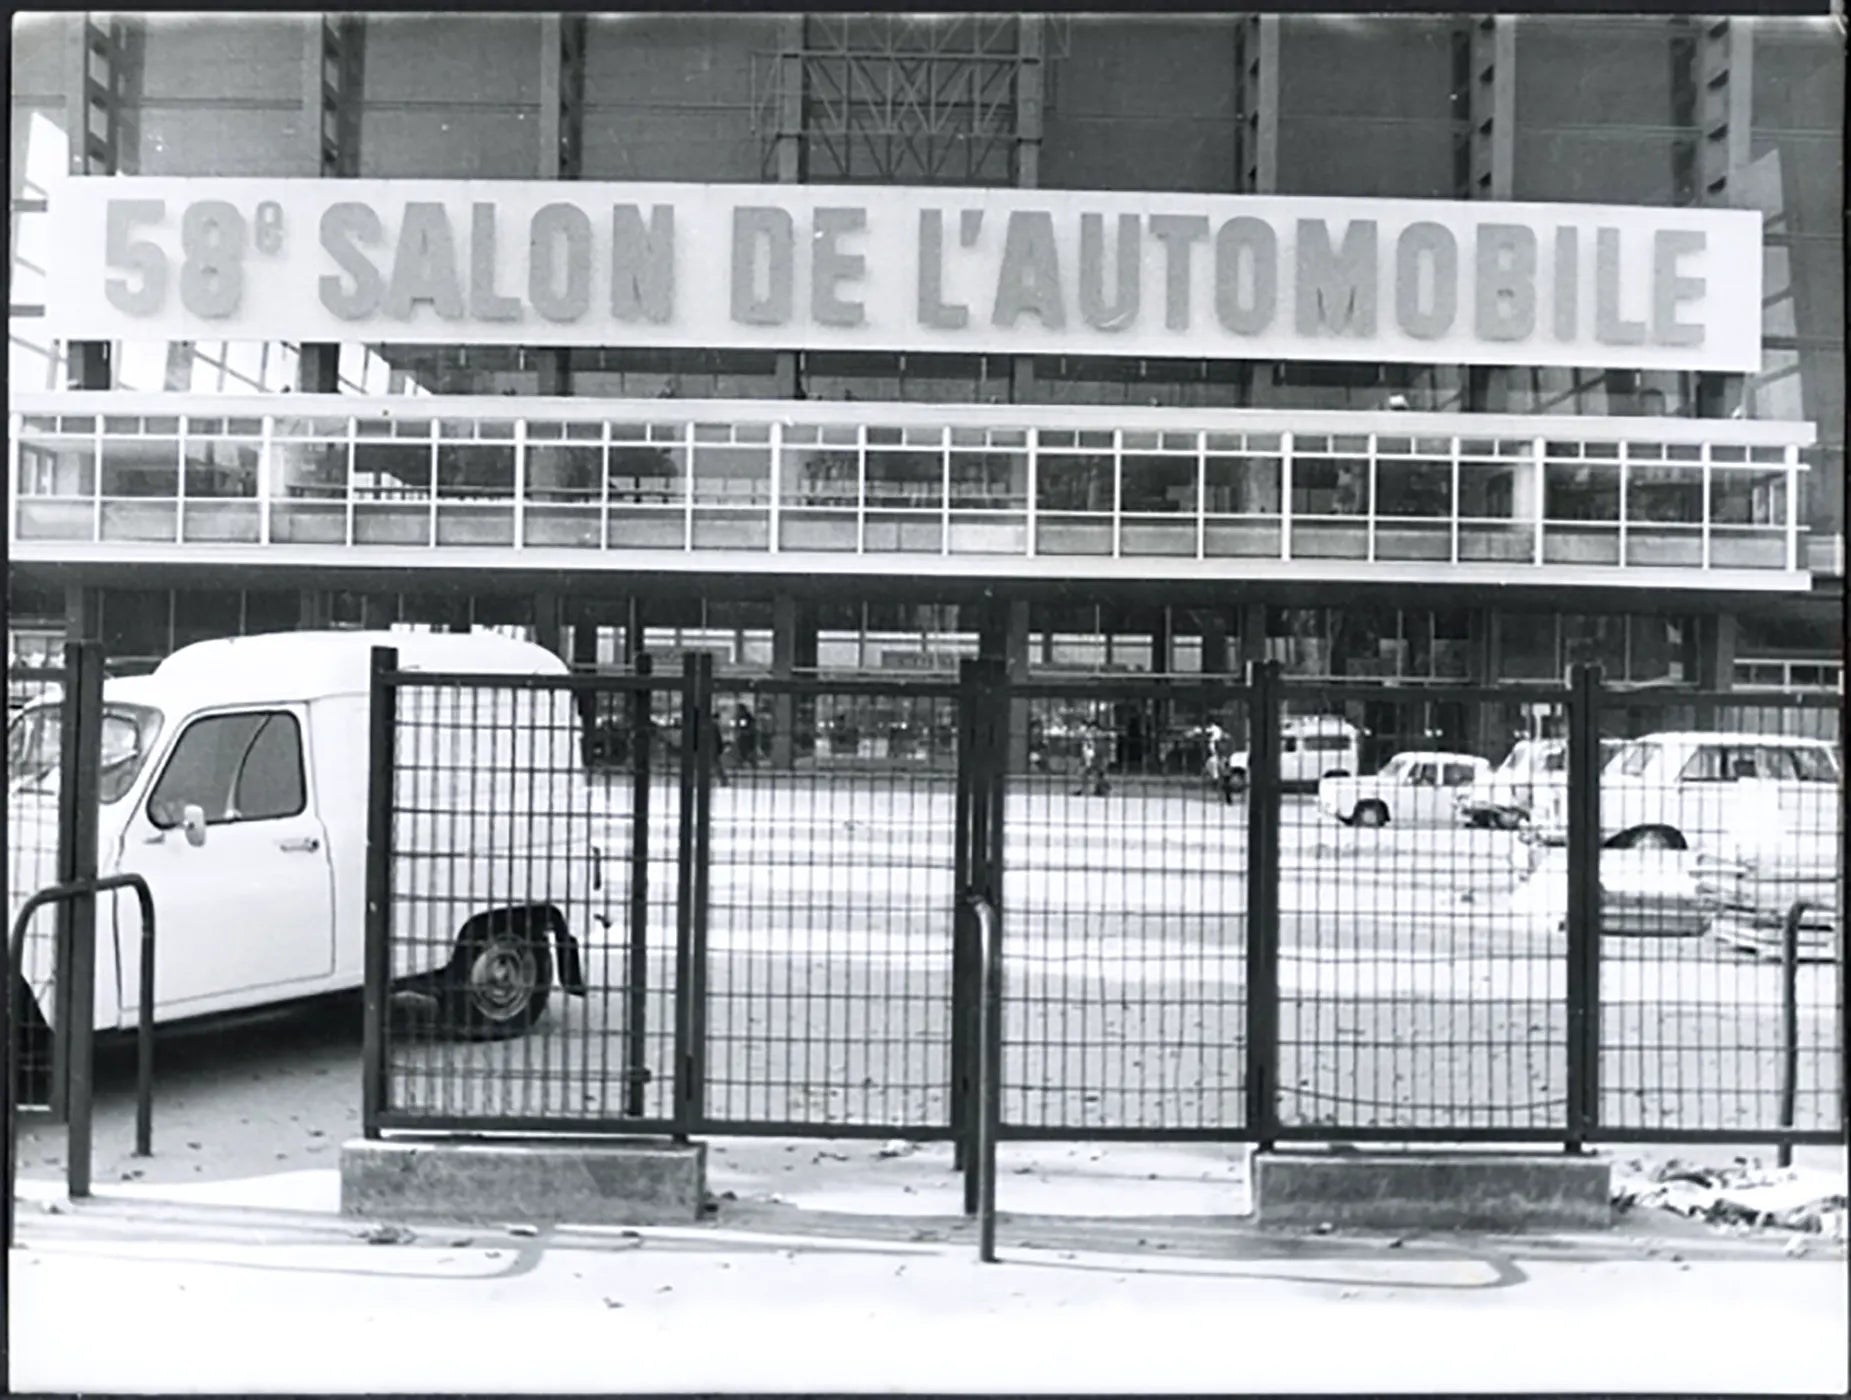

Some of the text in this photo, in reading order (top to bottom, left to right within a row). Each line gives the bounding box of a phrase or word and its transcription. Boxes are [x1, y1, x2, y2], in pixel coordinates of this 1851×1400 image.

[318, 202, 676, 326] SALON
[731, 205, 868, 330] DE
[917, 208, 1706, 348] L'AUTOMOBILE
